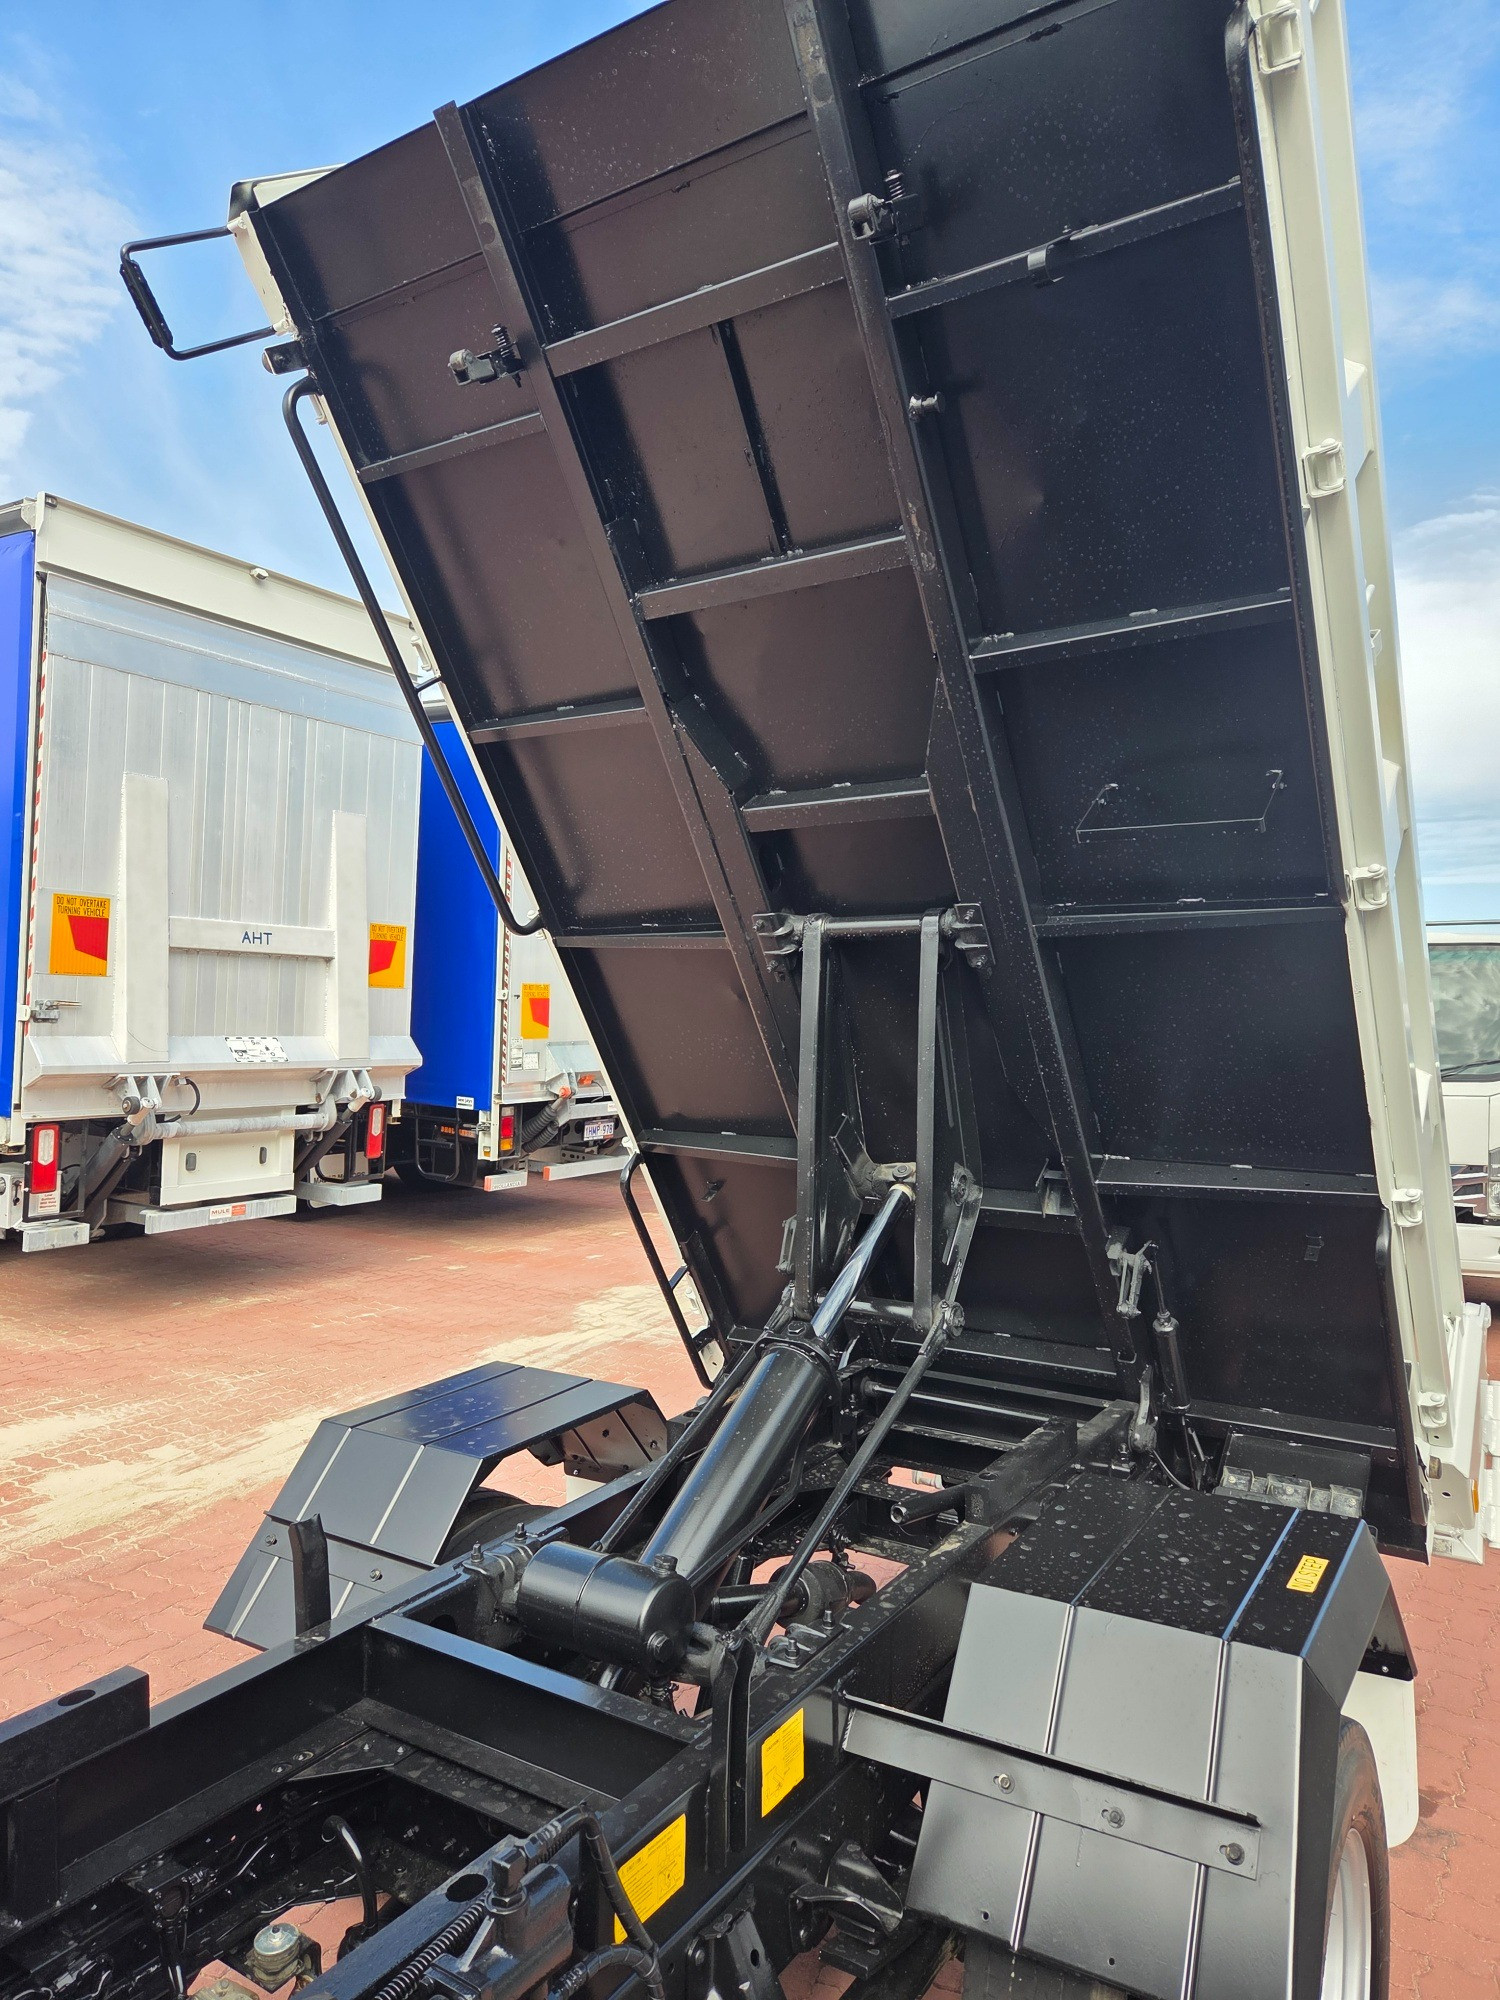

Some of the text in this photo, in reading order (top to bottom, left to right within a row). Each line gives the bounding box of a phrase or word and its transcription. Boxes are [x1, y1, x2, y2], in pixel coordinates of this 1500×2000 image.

[57, 896, 107, 909] DO NOT OVERTAKE
[58, 904, 106, 917] TURNING VEHICLE
[241, 931, 273, 945] AHT
[1291, 1558, 1324, 1591] NO STEP
